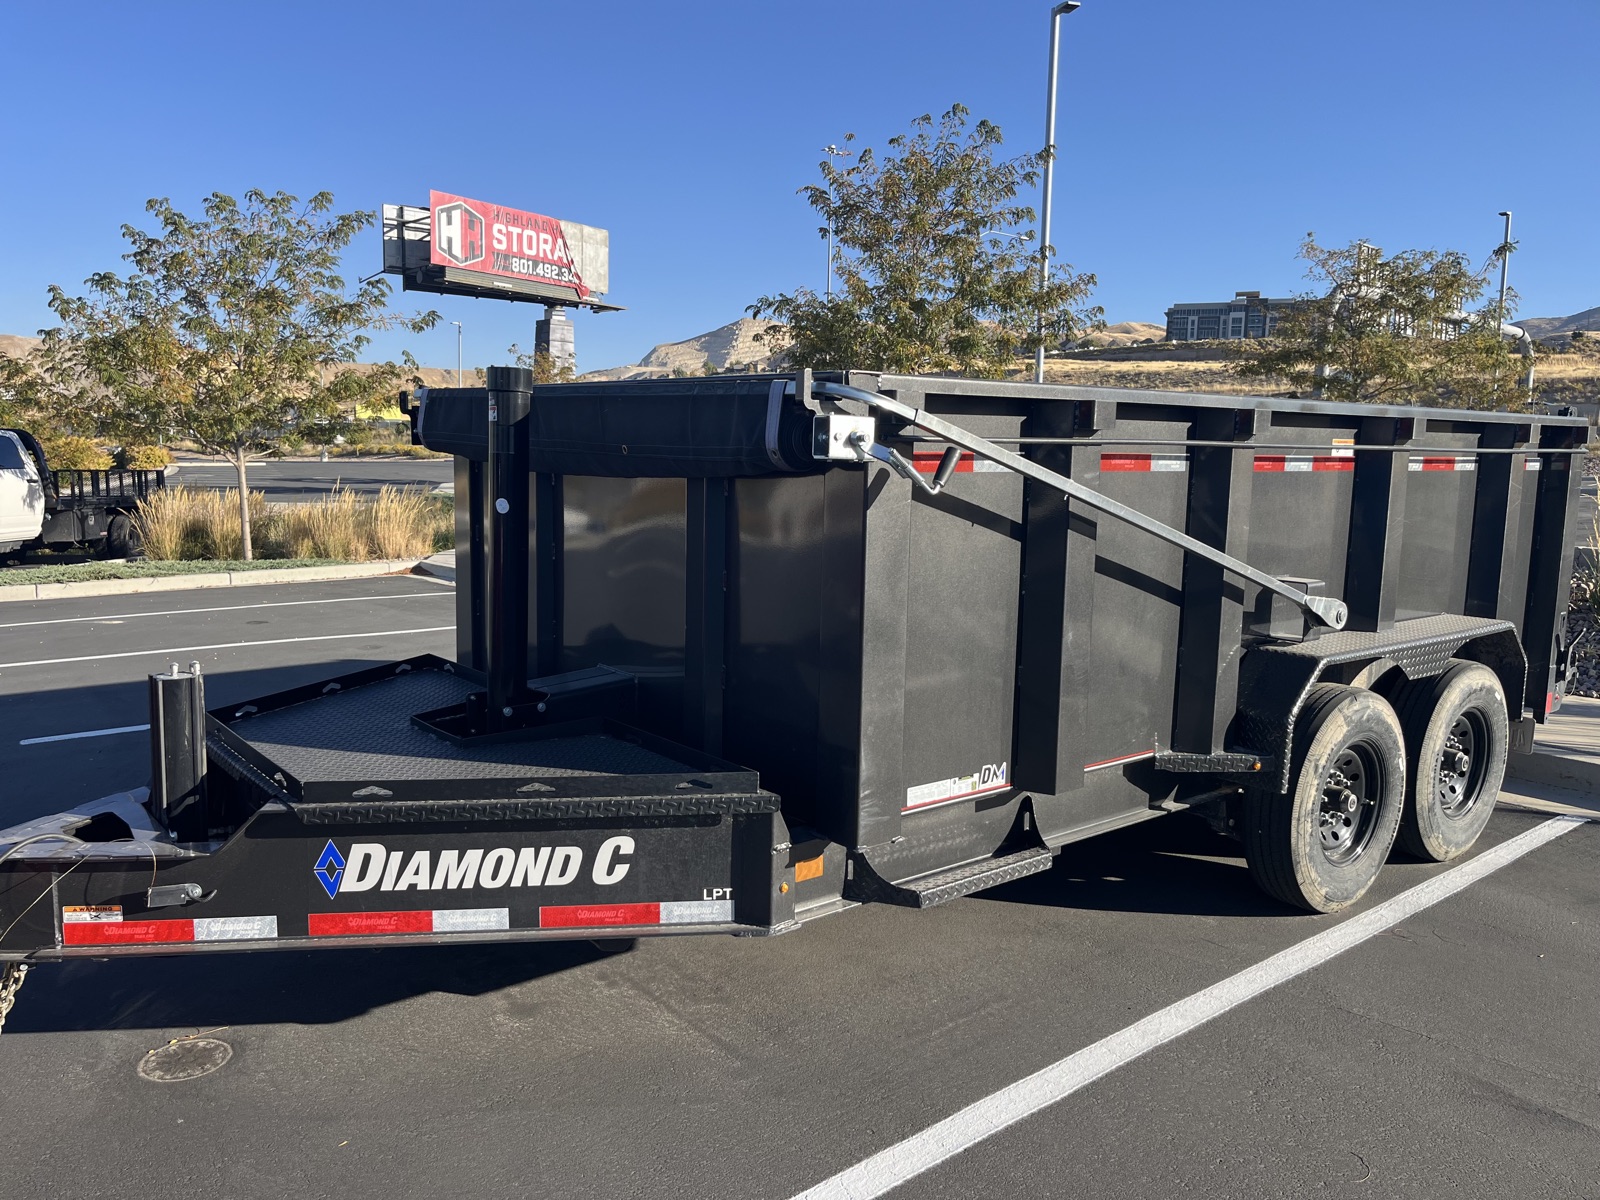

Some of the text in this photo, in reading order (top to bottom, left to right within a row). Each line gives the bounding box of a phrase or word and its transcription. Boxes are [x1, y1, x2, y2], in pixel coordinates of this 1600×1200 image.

[493, 210, 548, 232] HIGHLAND
[339, 836, 635, 893] DIAMOND C
[703, 888, 733, 900] LPT
[352, 917, 391, 925] DIAMOND
[108, 925, 156, 935] DIAMOND C
